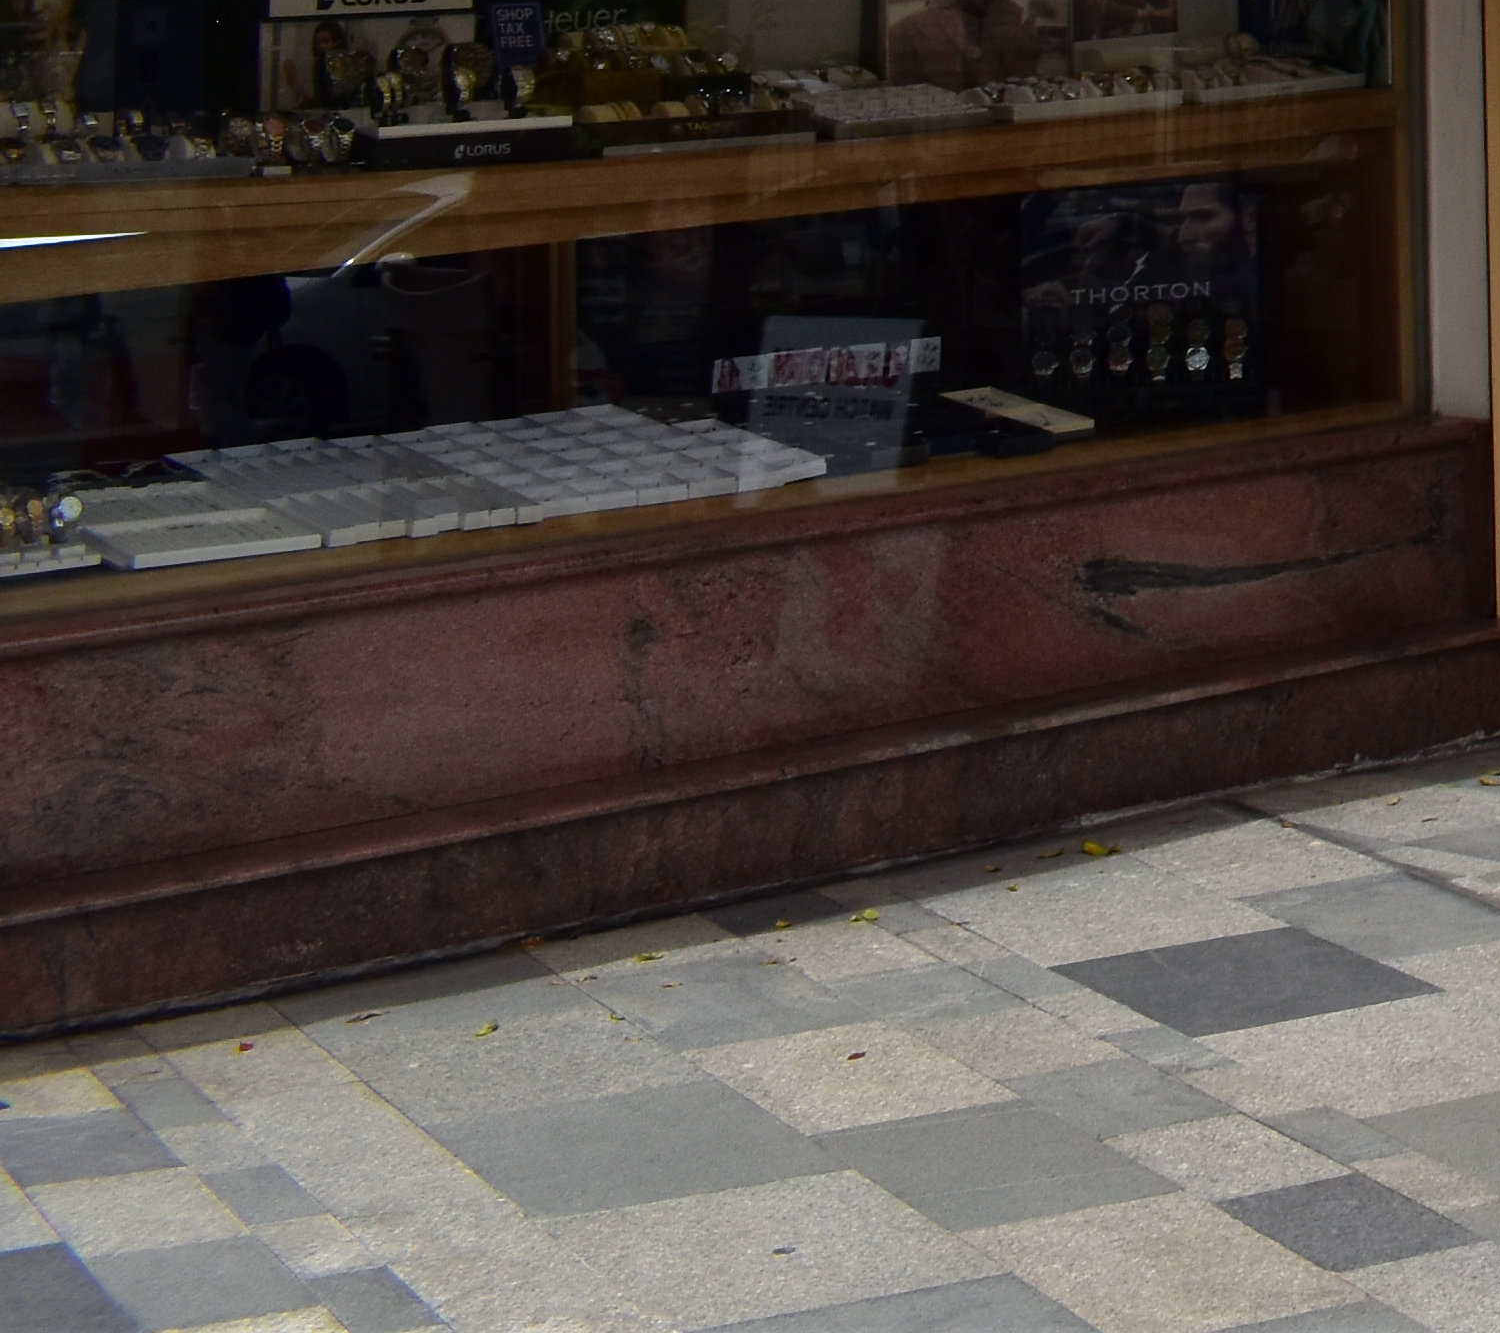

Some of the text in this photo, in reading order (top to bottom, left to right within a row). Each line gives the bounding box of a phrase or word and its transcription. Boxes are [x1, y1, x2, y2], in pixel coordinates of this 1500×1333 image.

[496, 8, 534, 21] SHOP
[498, 23, 525, 34] TAX
[500, 35, 535, 48] FREE
[466, 141, 511, 158] LORUS
[1070, 280, 1212, 307] THORTON
